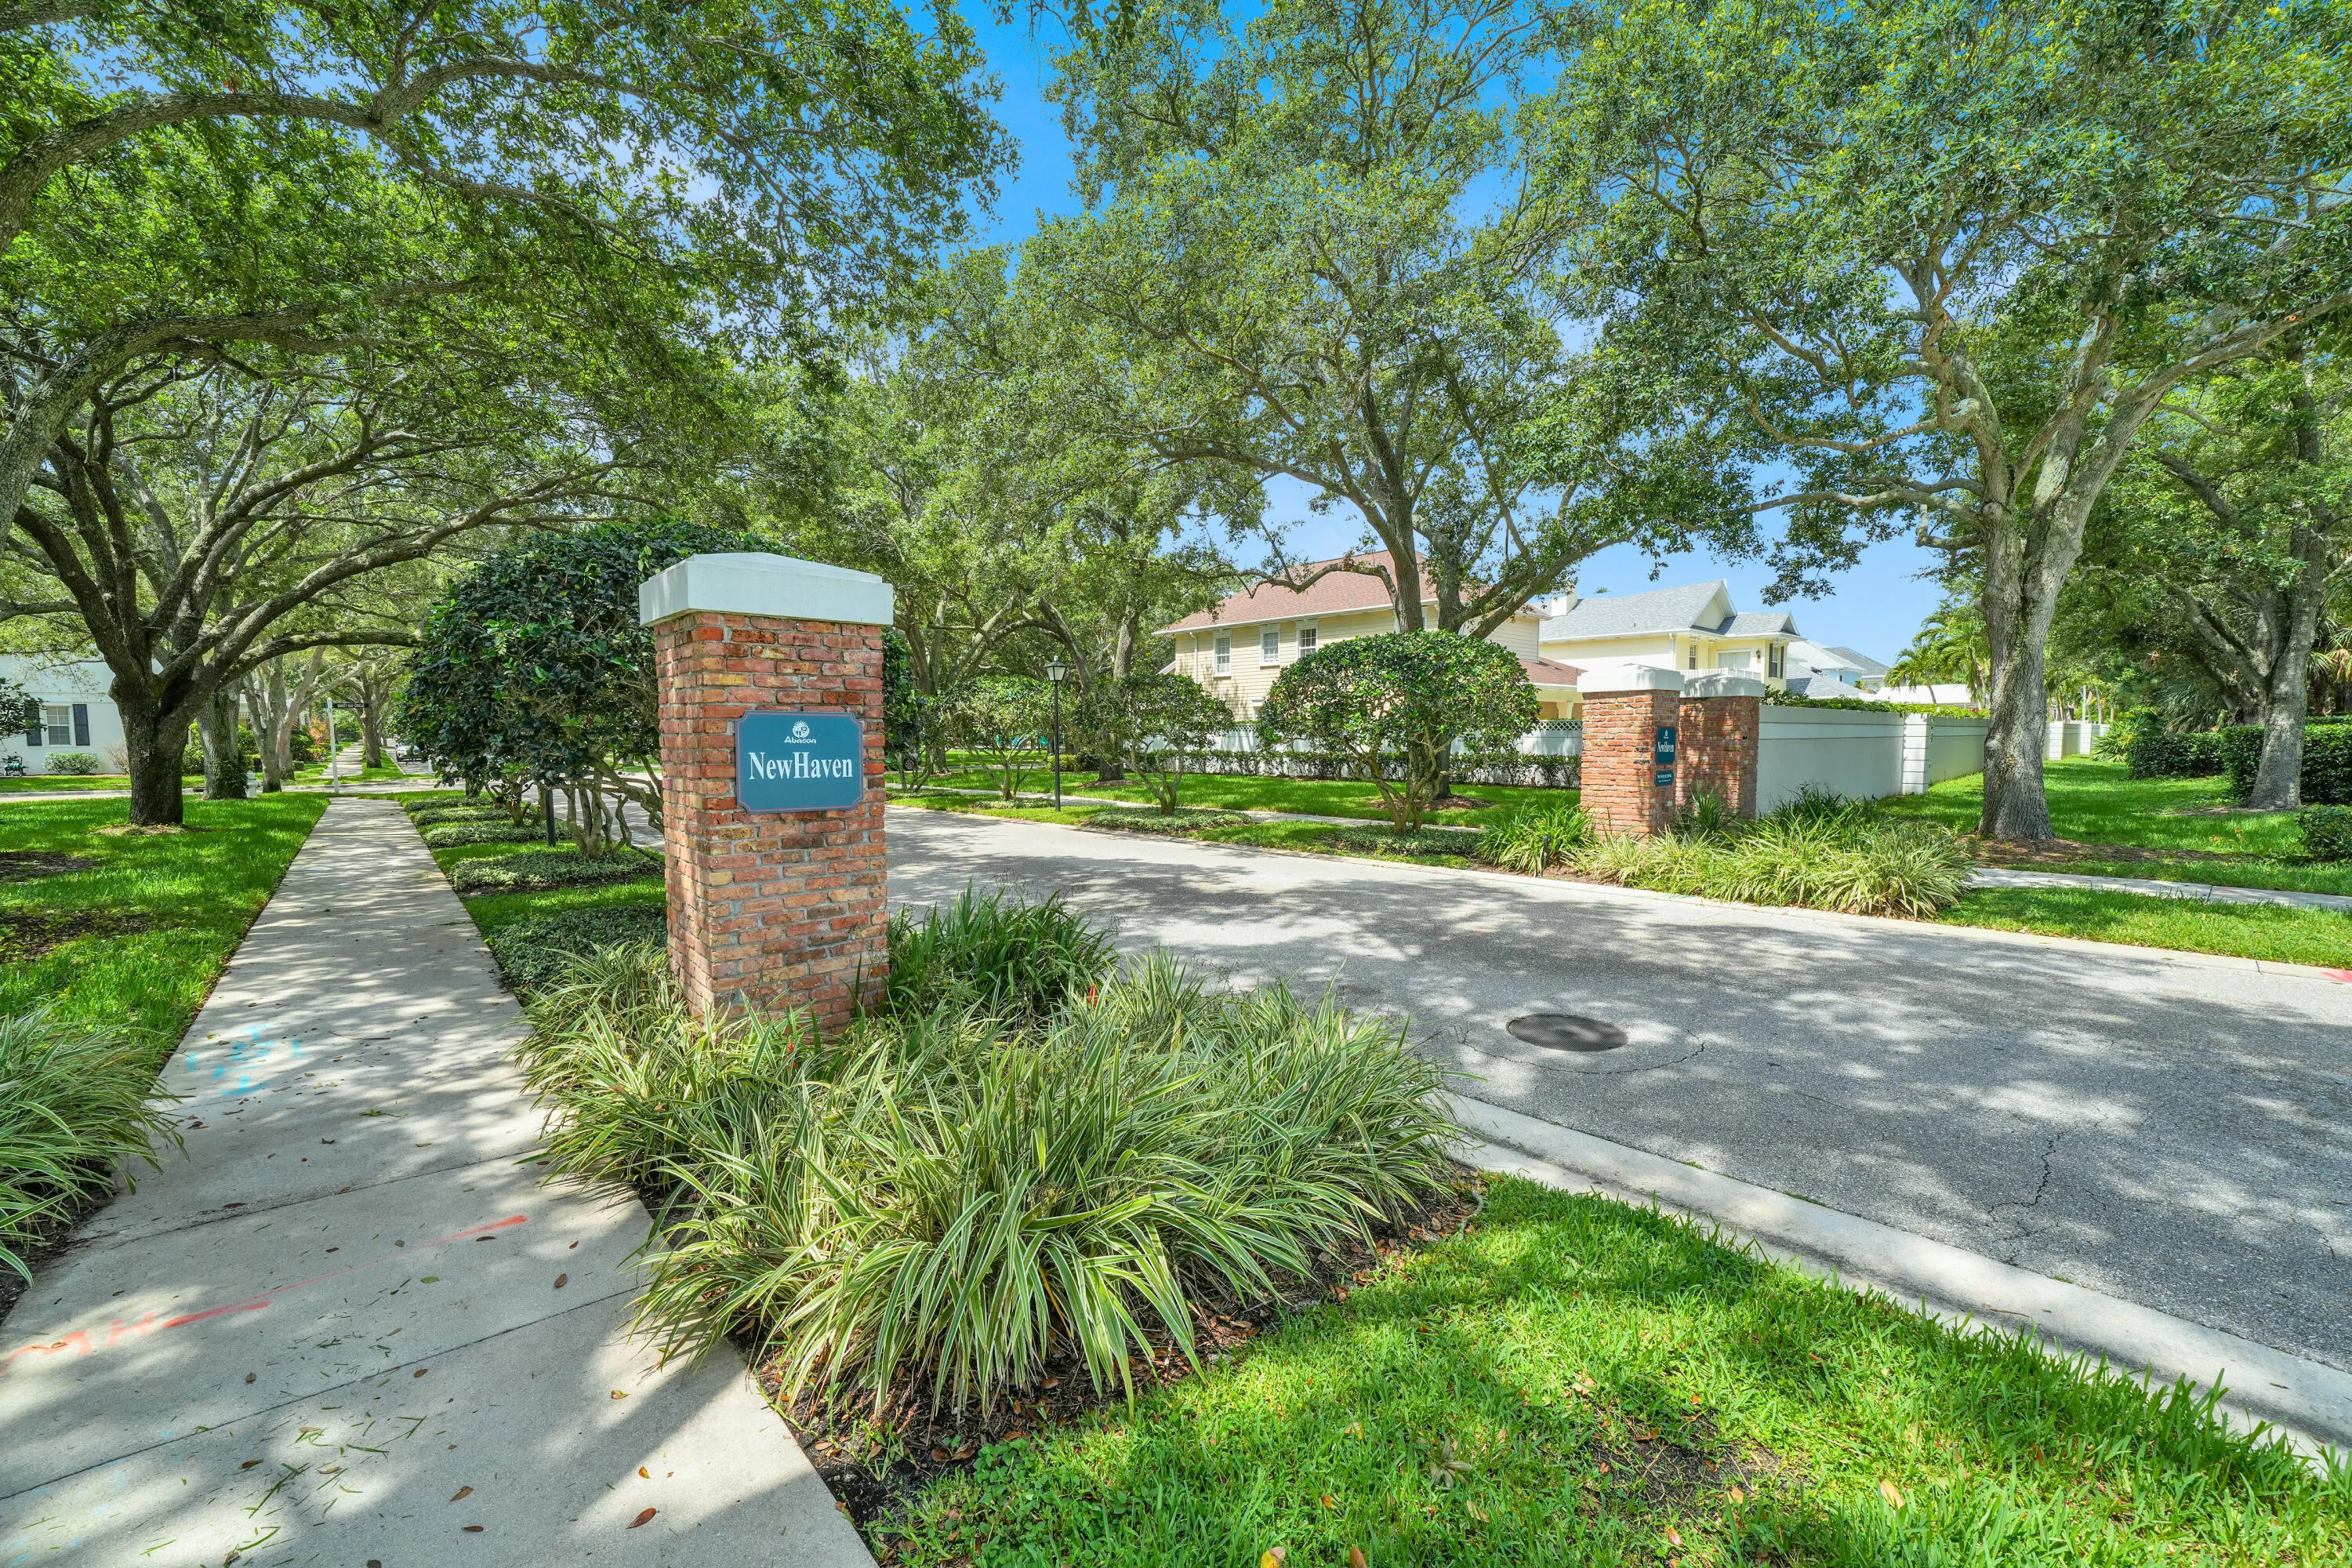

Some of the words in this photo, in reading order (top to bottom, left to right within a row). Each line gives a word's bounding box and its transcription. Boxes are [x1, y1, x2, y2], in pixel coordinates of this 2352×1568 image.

[784, 735, 817, 744] Abacoa
[1657, 741, 1675, 753] NewHaven
[748, 751, 853, 780] NewHaven
